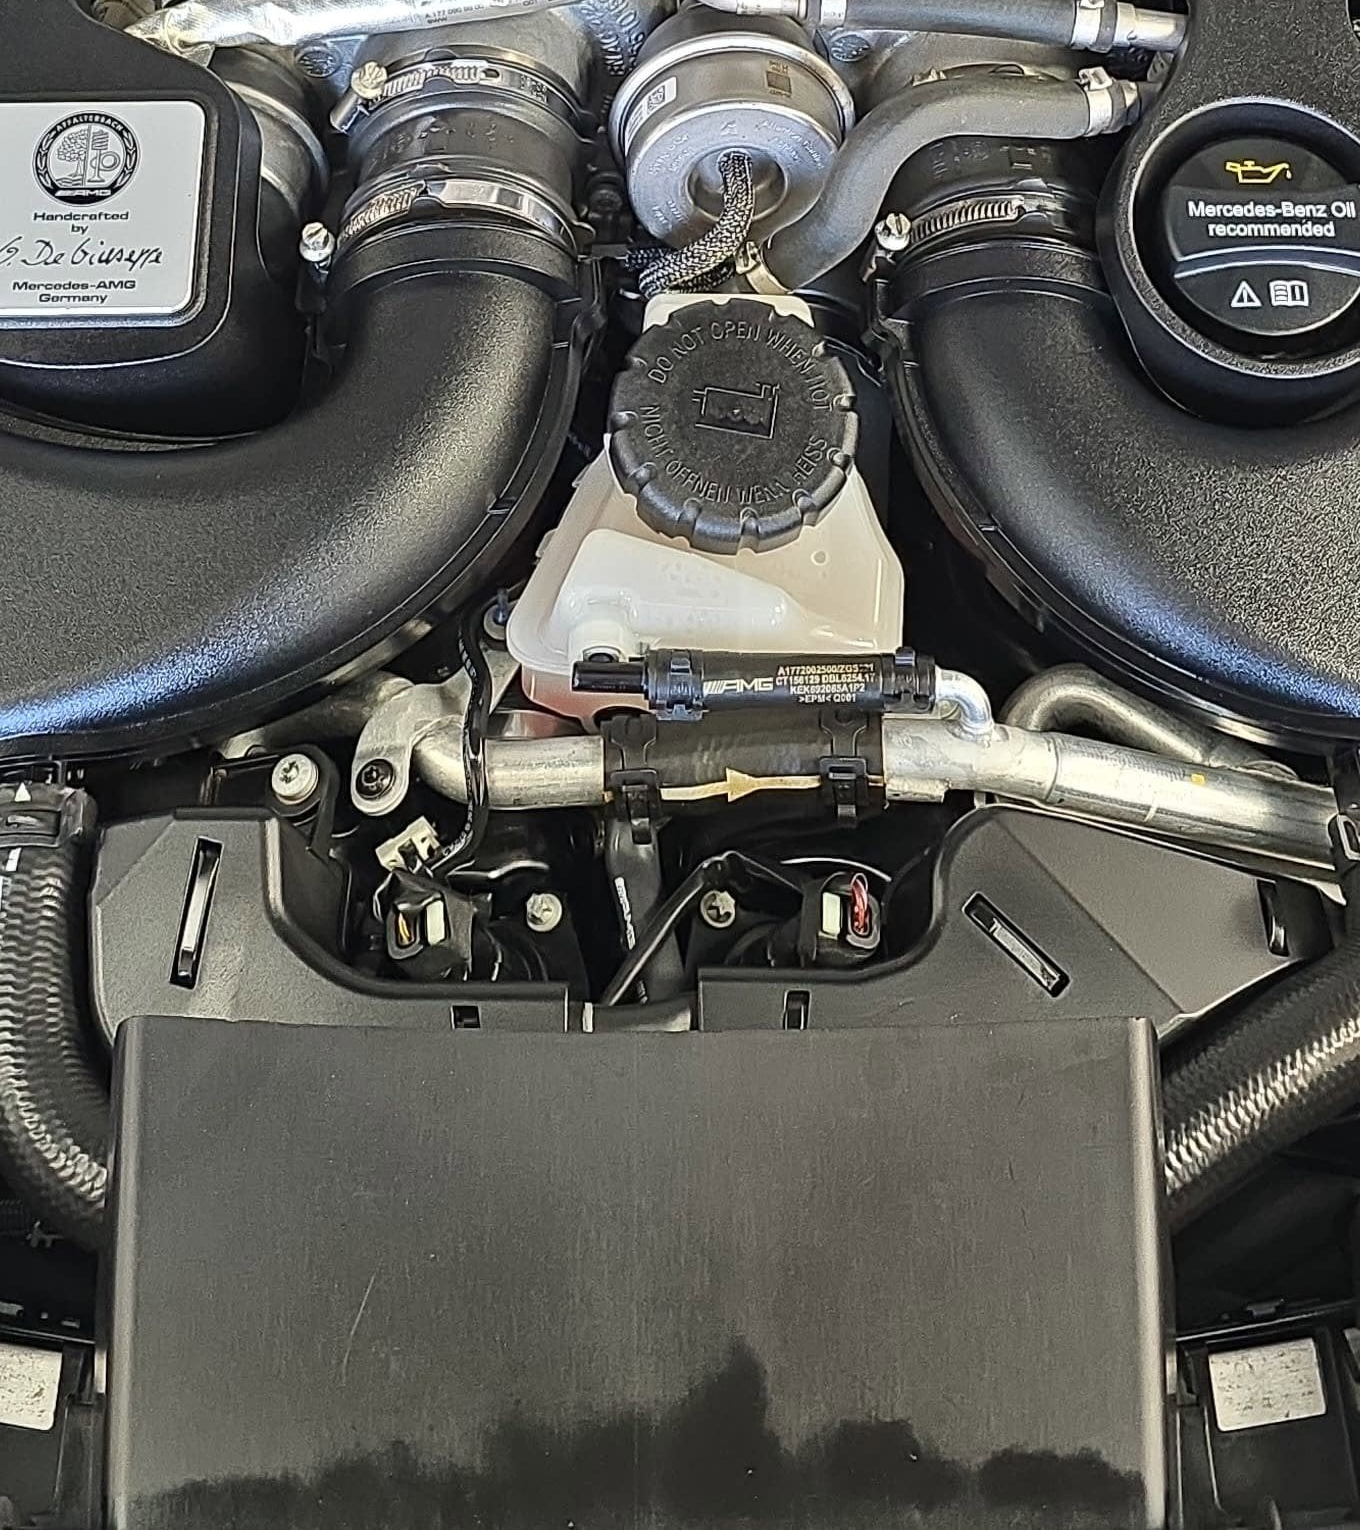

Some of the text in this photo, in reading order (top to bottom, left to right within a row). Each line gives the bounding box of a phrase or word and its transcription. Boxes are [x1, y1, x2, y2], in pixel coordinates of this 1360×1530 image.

[33, 211, 129, 222] Handcrafted
[1187, 200, 1357, 218] Mercedes-Benz Oil
[70, 223, 89, 234] by
[1207, 221, 1337, 238] recommended
[21, 239, 66, 266] De
[12, 279, 137, 291] Mercedes-AMG
[39, 293, 109, 304] Germany
[647, 321, 833, 413] DO NOT OPEN WHEN HOT
[640, 403, 675, 459] NICHT
[792, 435, 828, 486] HEISS
[721, 676, 774, 693] AMG
